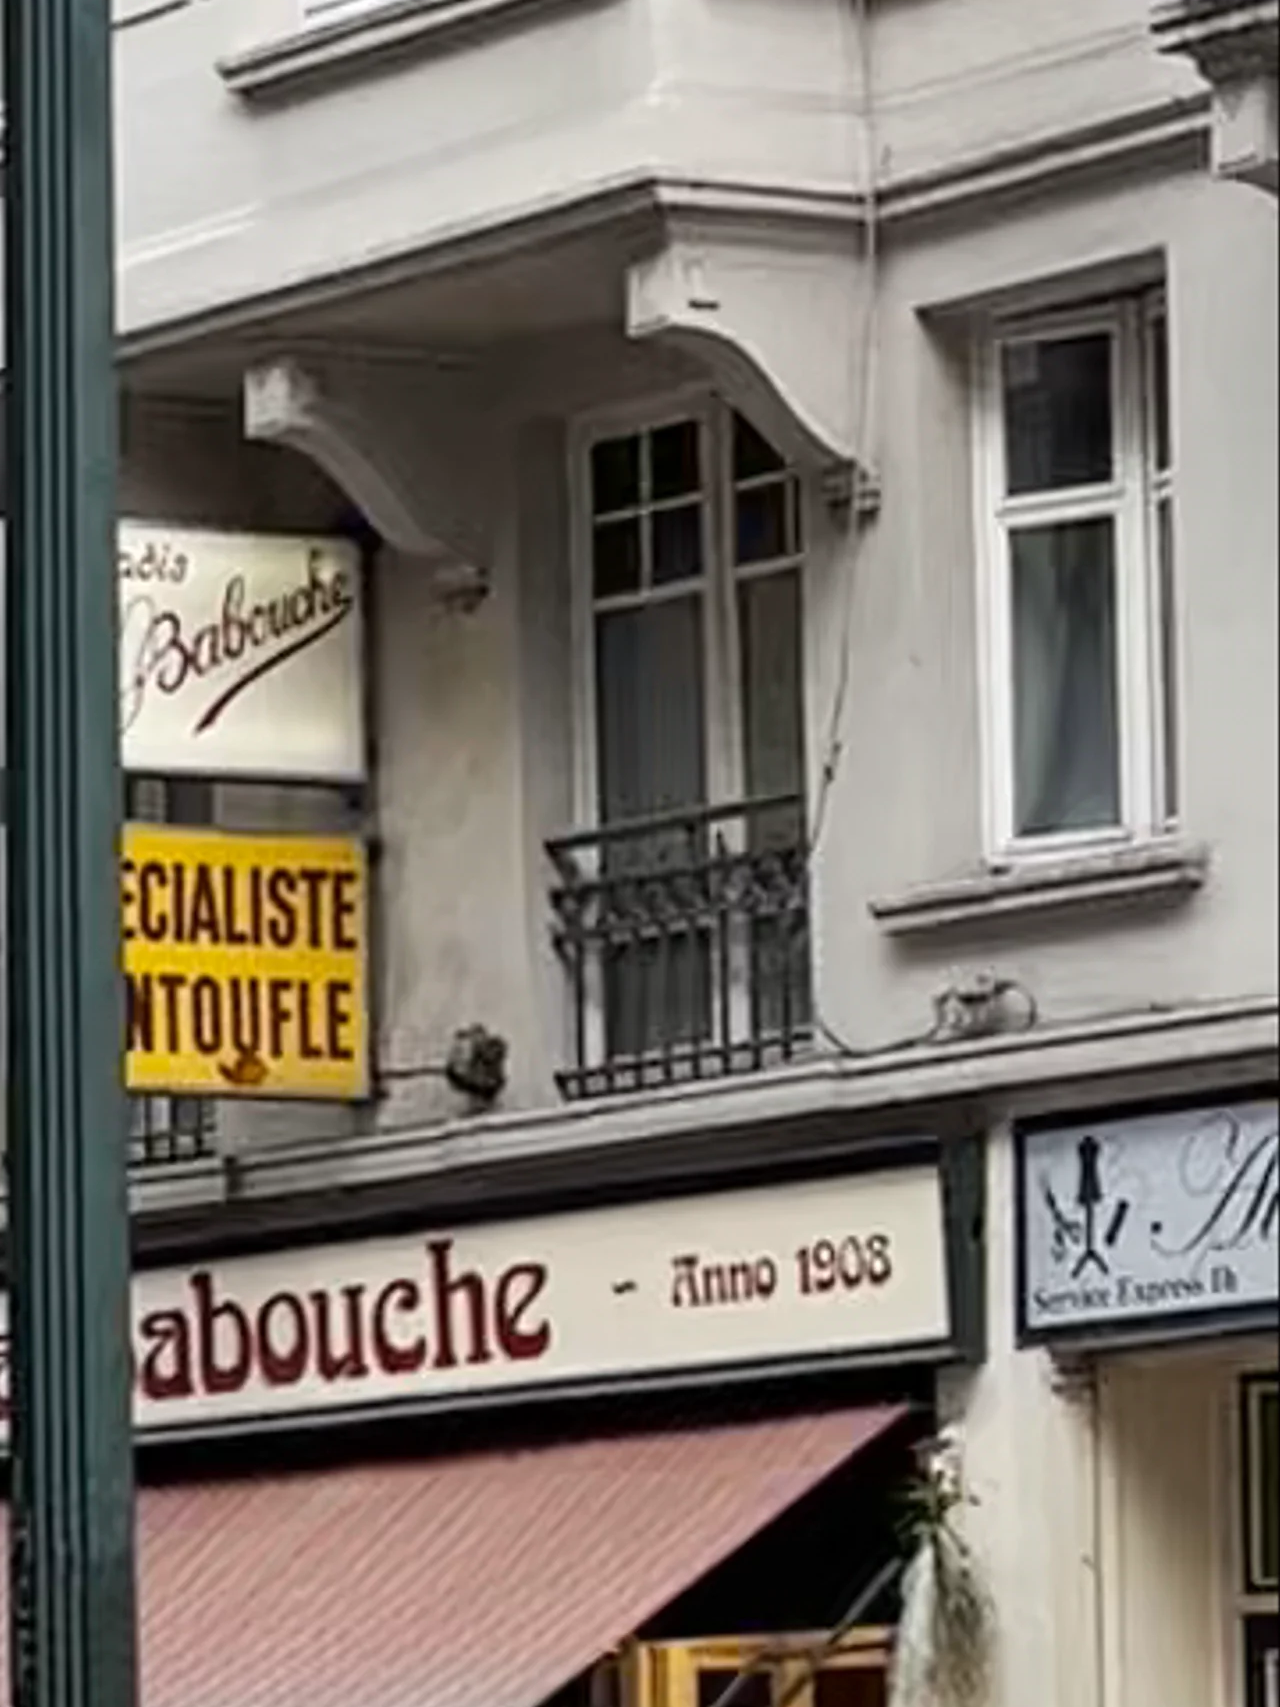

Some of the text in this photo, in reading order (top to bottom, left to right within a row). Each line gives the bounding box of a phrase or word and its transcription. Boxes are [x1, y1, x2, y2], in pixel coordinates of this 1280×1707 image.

[119, 543, 188, 584] adis
[123, 546, 353, 695] Babouche
[121, 860, 358, 950] ECIALISTE
[125, 973, 354, 1061] NTOUFLE
[130, 1238, 552, 1401] abouche
[670, 1253, 777, 1307] Anno
[796, 1233, 893, 1295] 1908
